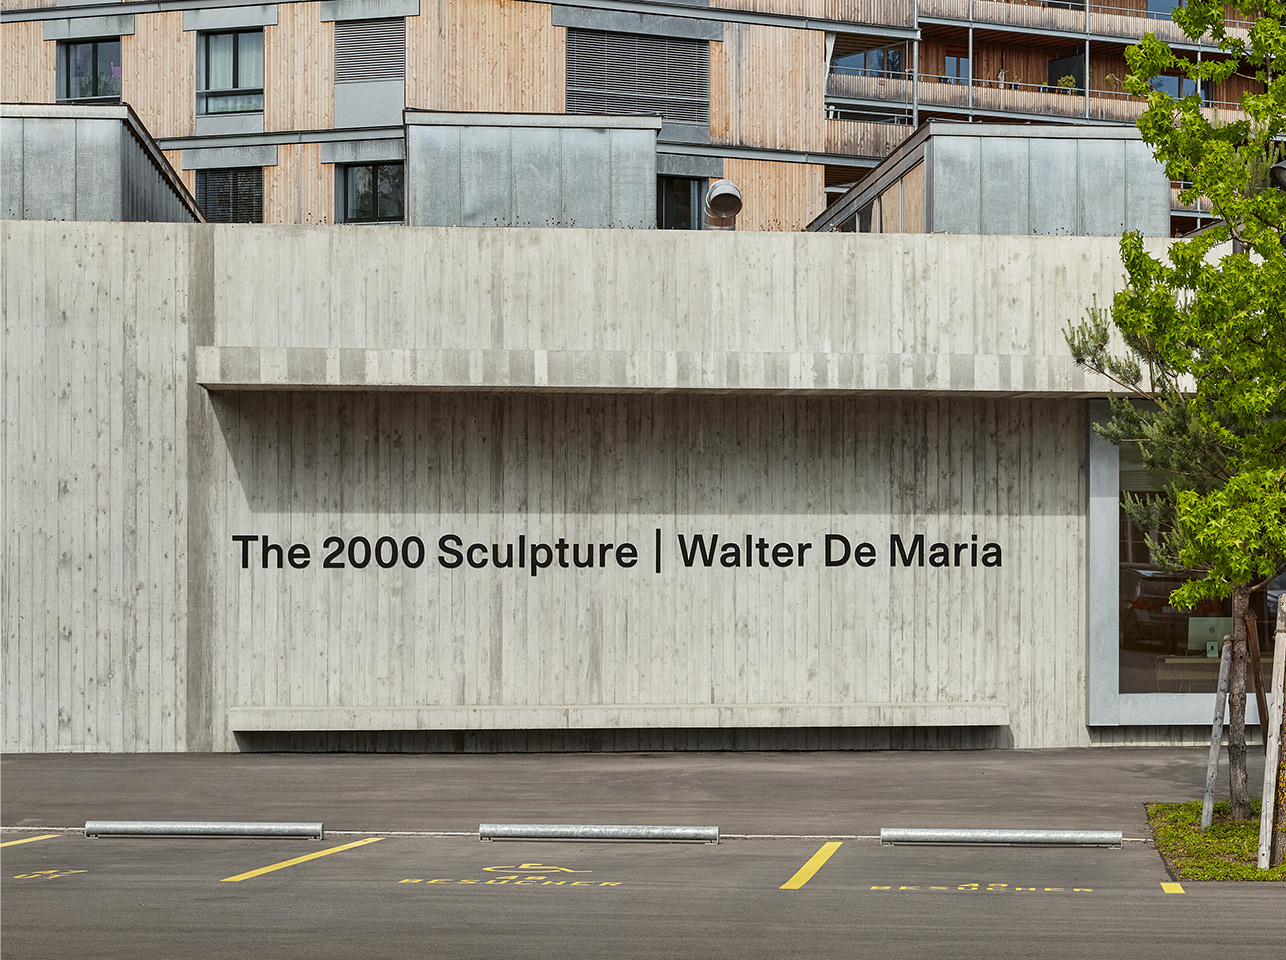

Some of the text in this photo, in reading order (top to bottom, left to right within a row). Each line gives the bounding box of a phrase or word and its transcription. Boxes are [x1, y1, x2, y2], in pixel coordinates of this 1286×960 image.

[231, 535, 311, 569] The
[322, 535, 425, 569] 2000
[437, 534, 638, 577] Sculpture
[677, 533, 812, 568] Walter
[824, 533, 877, 568] De
[890, 533, 1002, 568] Maria
[399, 878, 623, 887] BESUCHER
